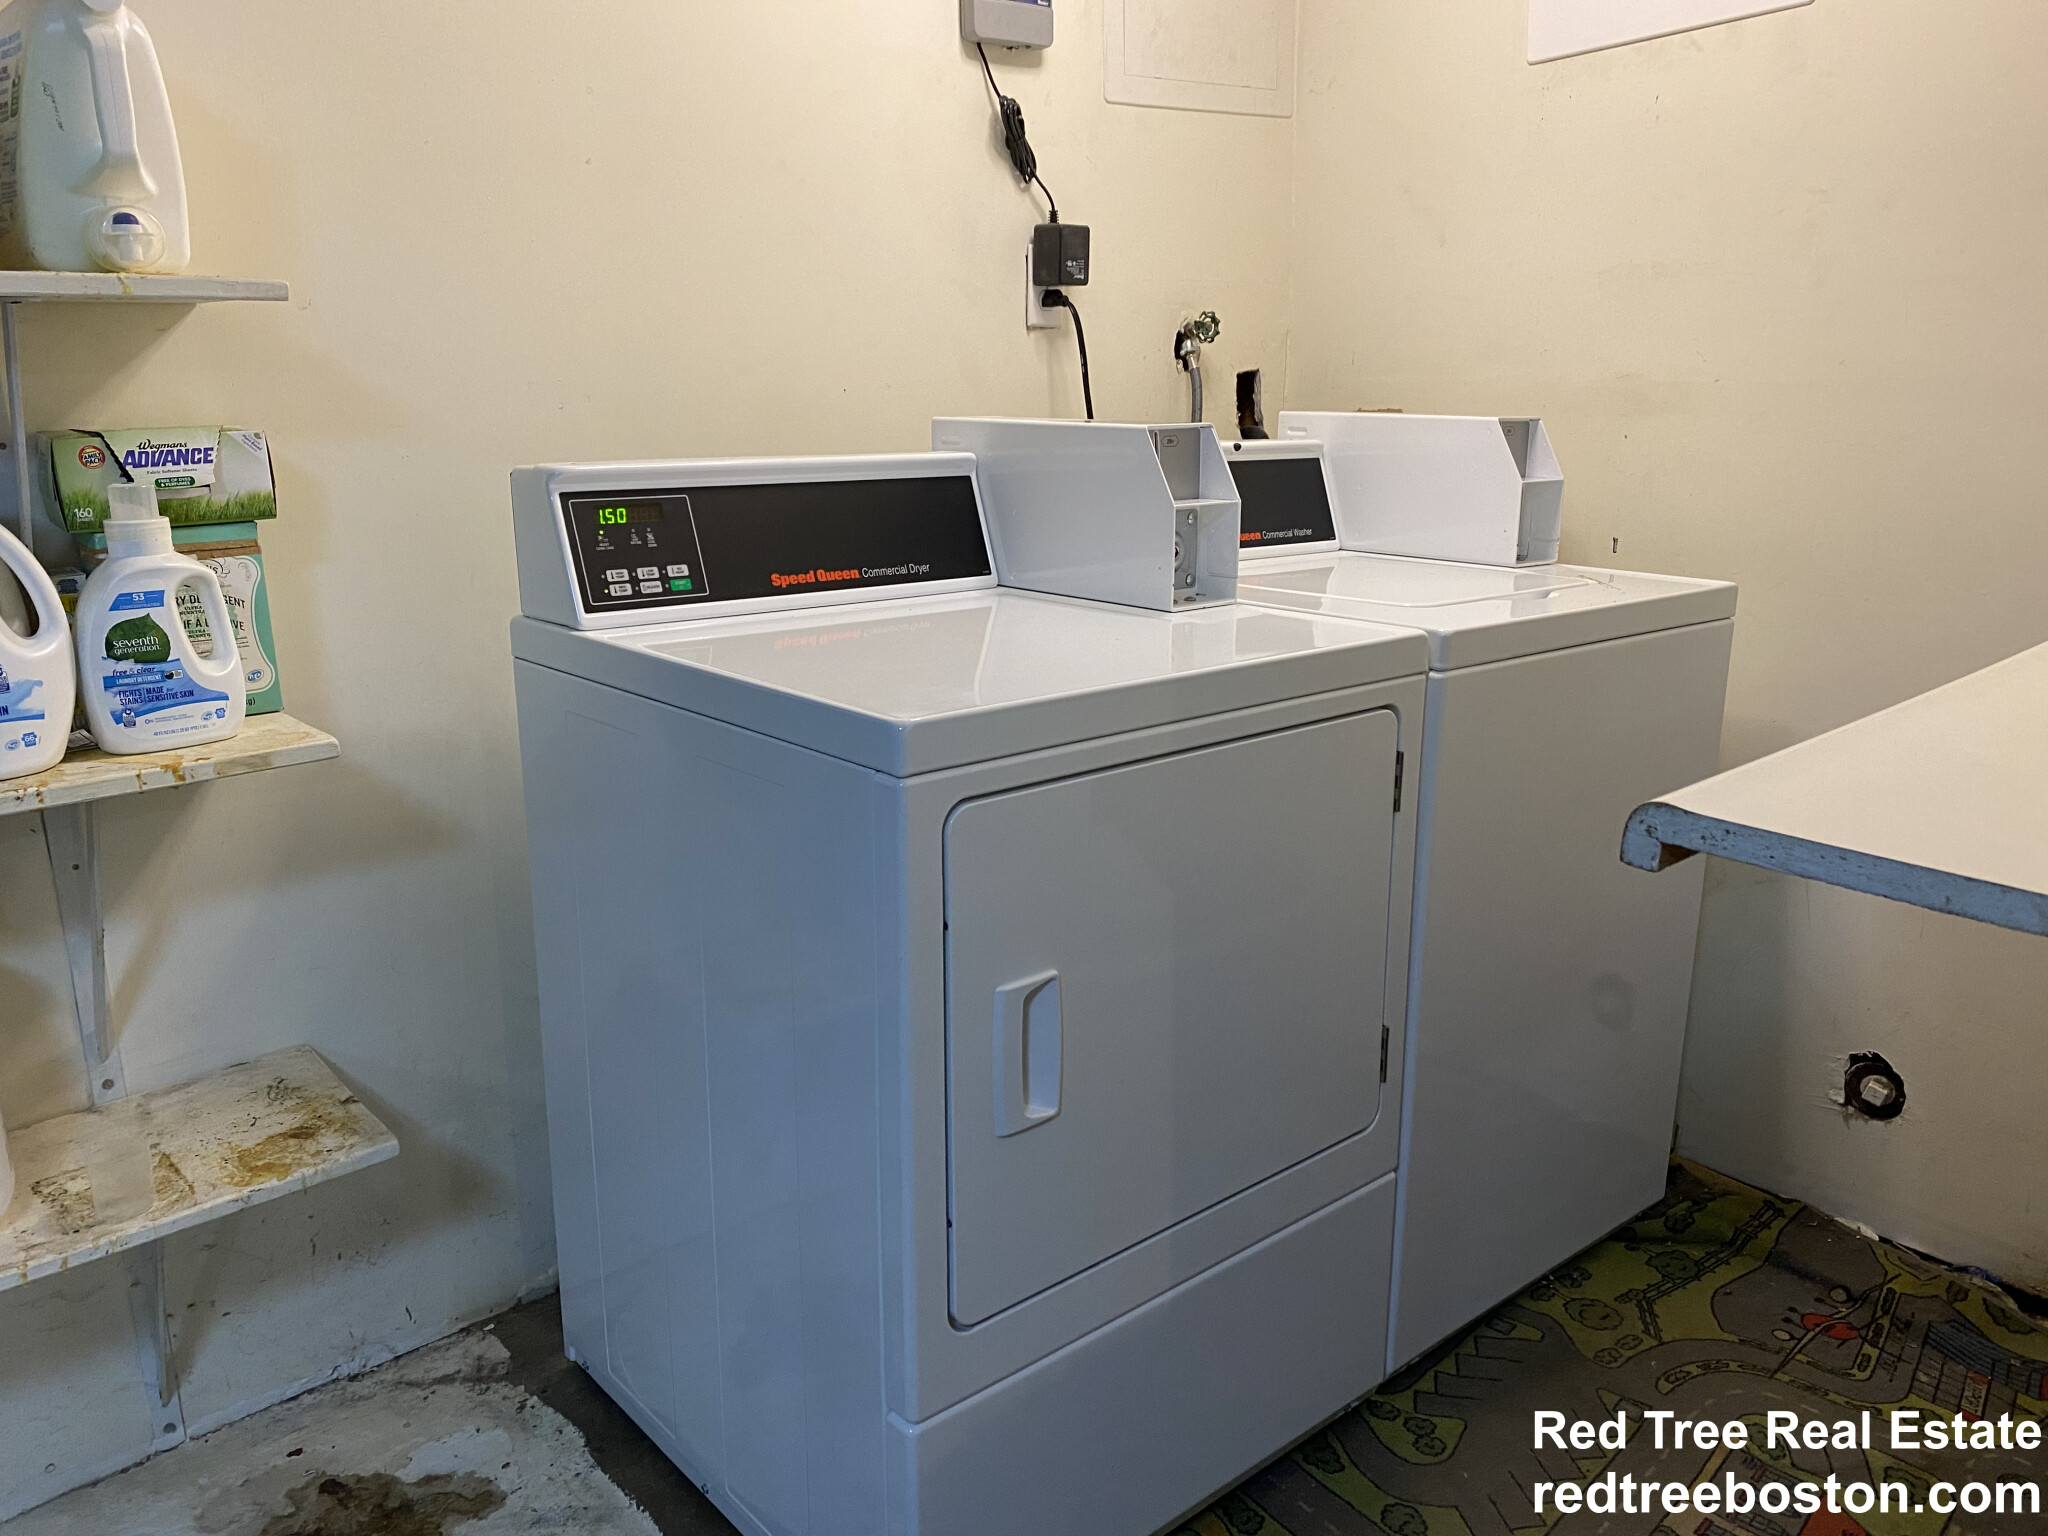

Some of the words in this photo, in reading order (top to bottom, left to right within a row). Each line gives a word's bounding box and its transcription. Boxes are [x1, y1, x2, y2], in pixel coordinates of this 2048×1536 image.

[136, 438, 188, 454] Wegmans
[85, 457, 102, 466] PACK
[121, 447, 214, 469] ADVANCE
[73, 508, 93, 518] 160
[1239, 532, 1262, 541] ueen
[1262, 529, 1293, 540] Commercial
[1294, 528, 1312, 537] Washer
[770, 570, 815, 588] Speed
[816, 569, 860, 582] Queen
[861, 564, 908, 578] Commercial
[909, 563, 930, 575] Dryer
[132, 593, 145, 601] 53
[113, 635, 159, 649] seventh
[112, 669, 128, 677] free
[136, 666, 157, 674] clear
[116, 677, 137, 685] LAUNDRY
[137, 674, 161, 682] DETERGENT
[118, 688, 142, 698] FIGHTS
[145, 686, 164, 695] MADE
[147, 691, 179, 703] SENSITIVE
[179, 689, 194, 698] SKIN
[120, 697, 144, 706] STAINS
[24, 734, 35, 742] 66
